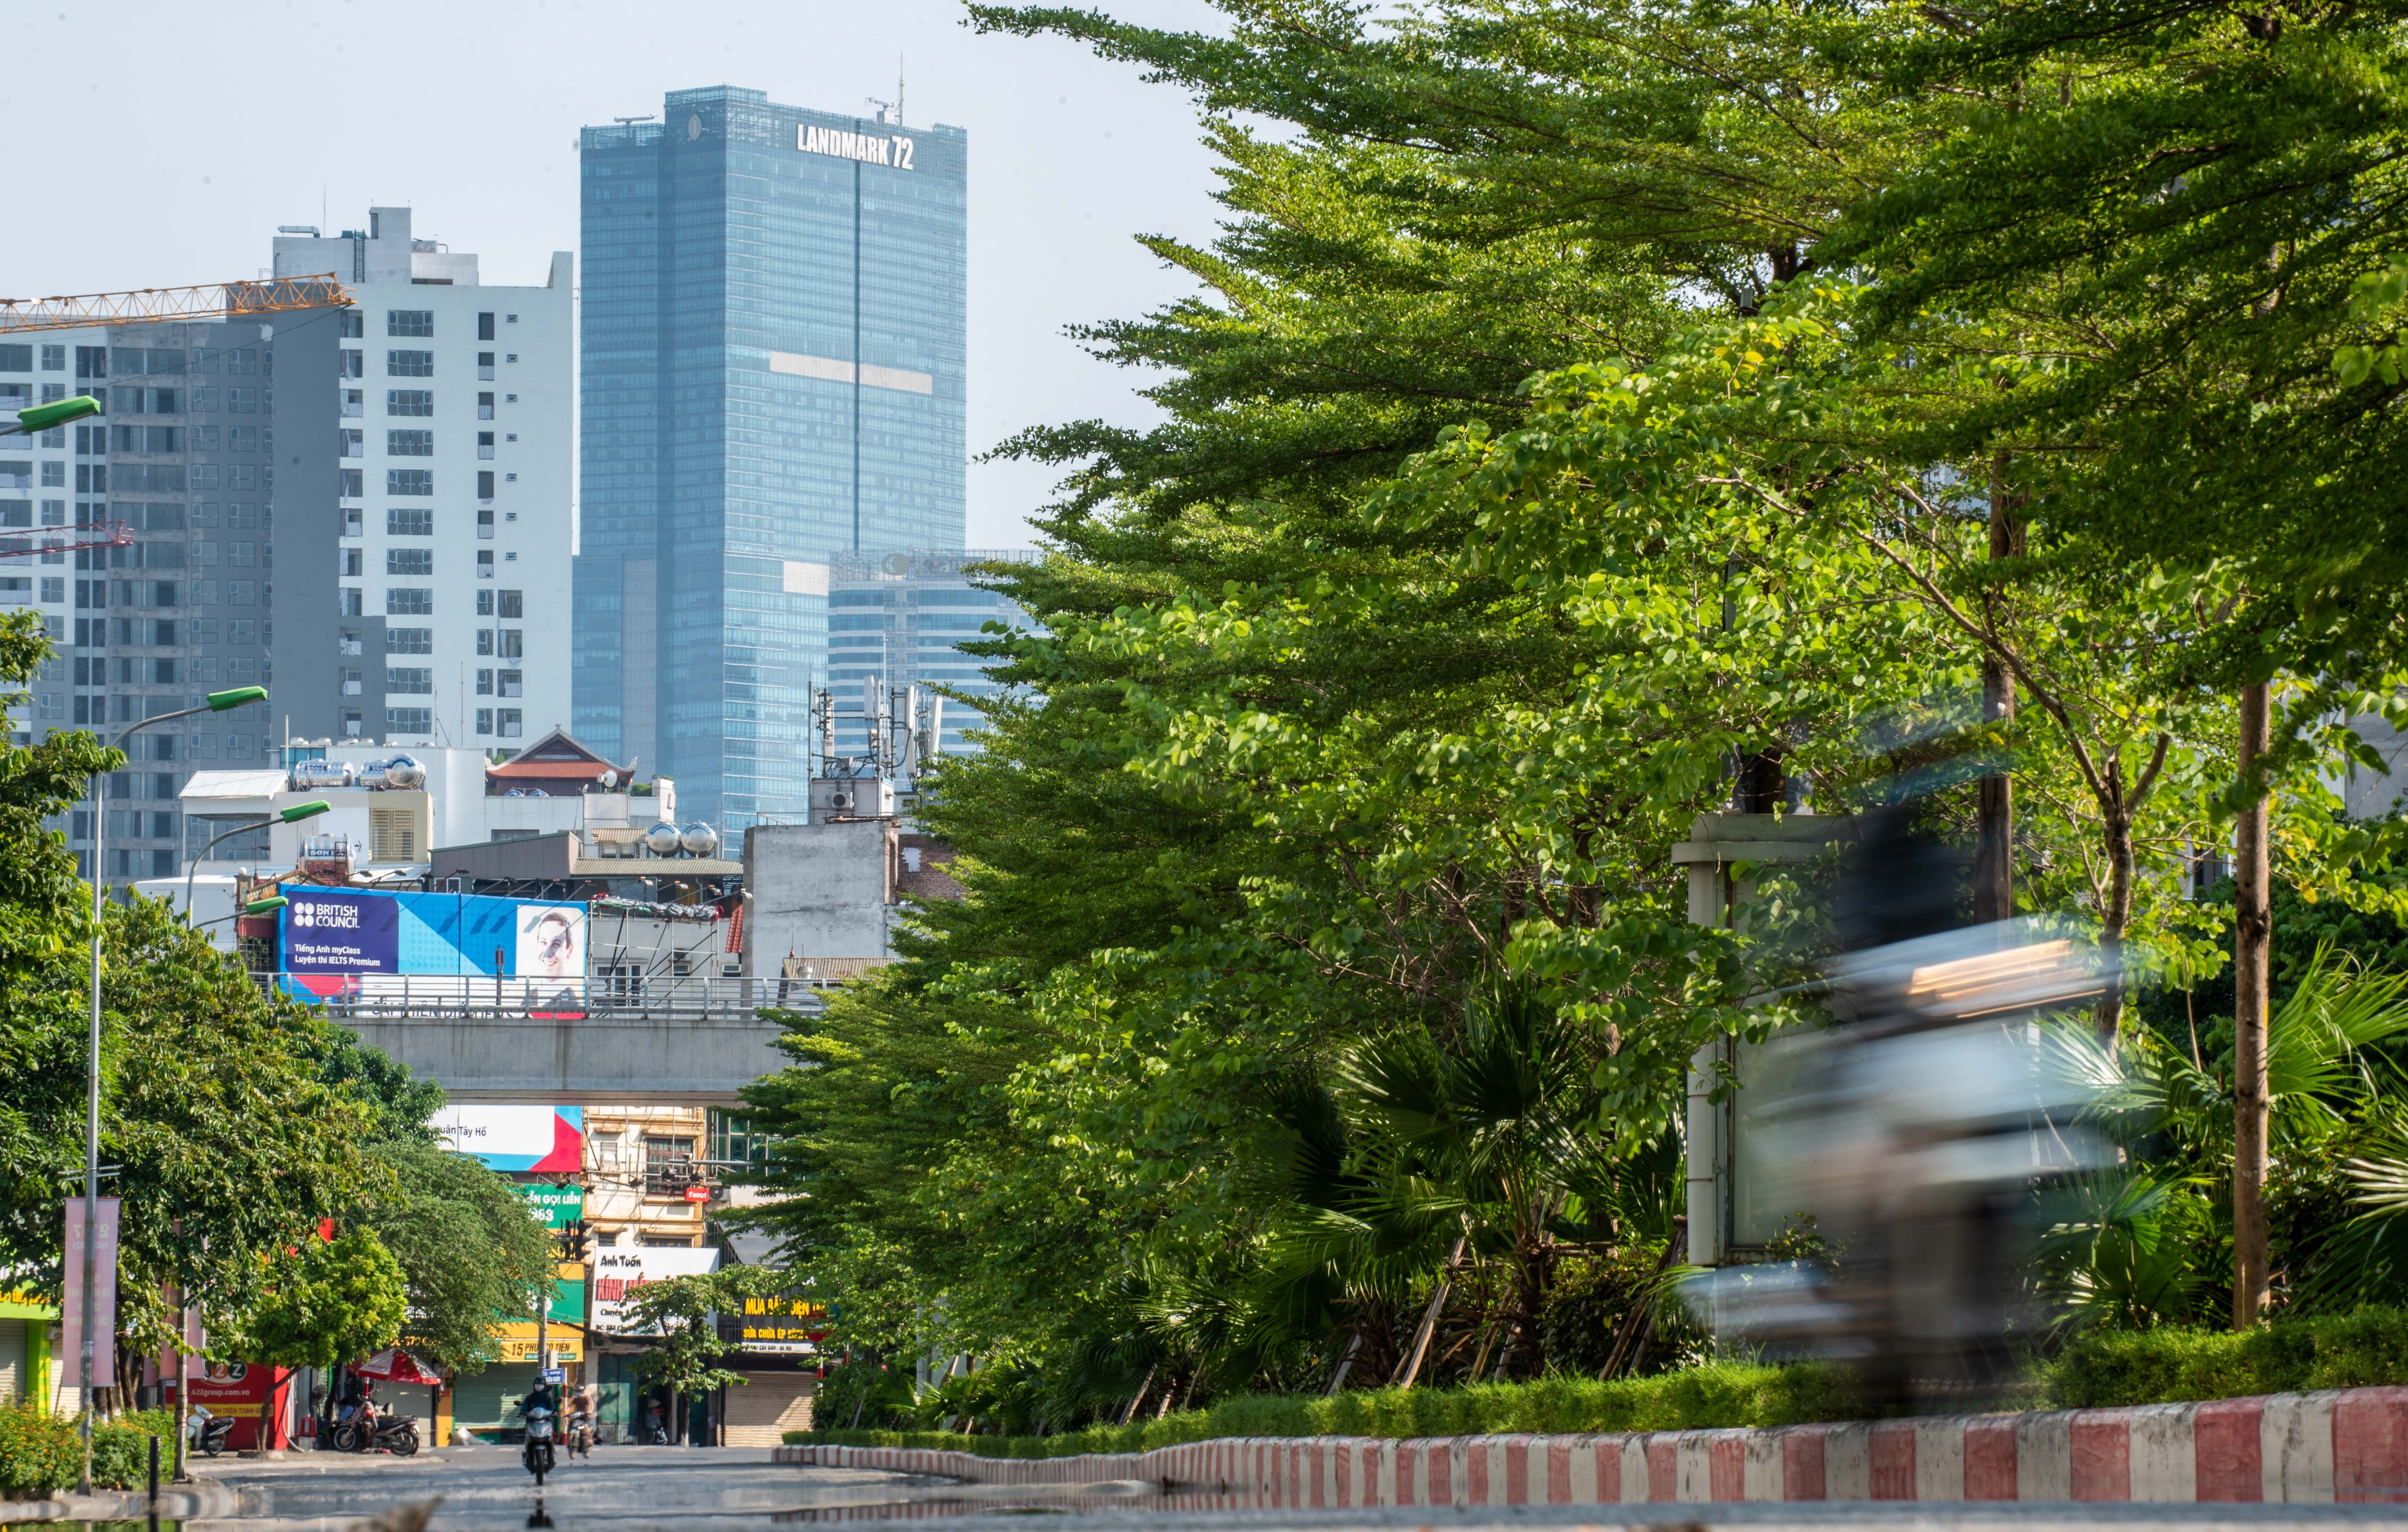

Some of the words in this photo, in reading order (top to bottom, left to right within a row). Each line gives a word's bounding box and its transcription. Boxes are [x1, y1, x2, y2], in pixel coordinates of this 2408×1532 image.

[797, 124, 889, 165] LANDMARK
[891, 136, 913, 170] 72
[317, 904, 358, 916] BRITISH
[316, 916, 360, 928] COUNCIL
[295, 943, 315, 954] Tiếng
[332, 946, 361, 955] myClass
[295, 955, 316, 965] Luyện
[329, 956, 347, 965] IELTS
[349, 957, 380, 966] Premium
[441, 1124, 456, 1137] uận
[458, 1126, 473, 1138] Tây
[475, 1126, 487, 1137] Hồ
[543, 1195, 560, 1206] GỌI
[563, 1191, 581, 1204] LIỀN
[601, 1255, 618, 1267] Anh
[619, 1254, 641, 1267] Tuấn
[596, 1274, 624, 1302] KÍNH
[745, 1298, 766, 1315] MUA
[743, 1325, 757, 1339] SỬA
[758, 1326, 776, 1339] CHỮA
[777, 1327, 786, 1339] ÉP
[512, 1343, 523, 1356] 15
